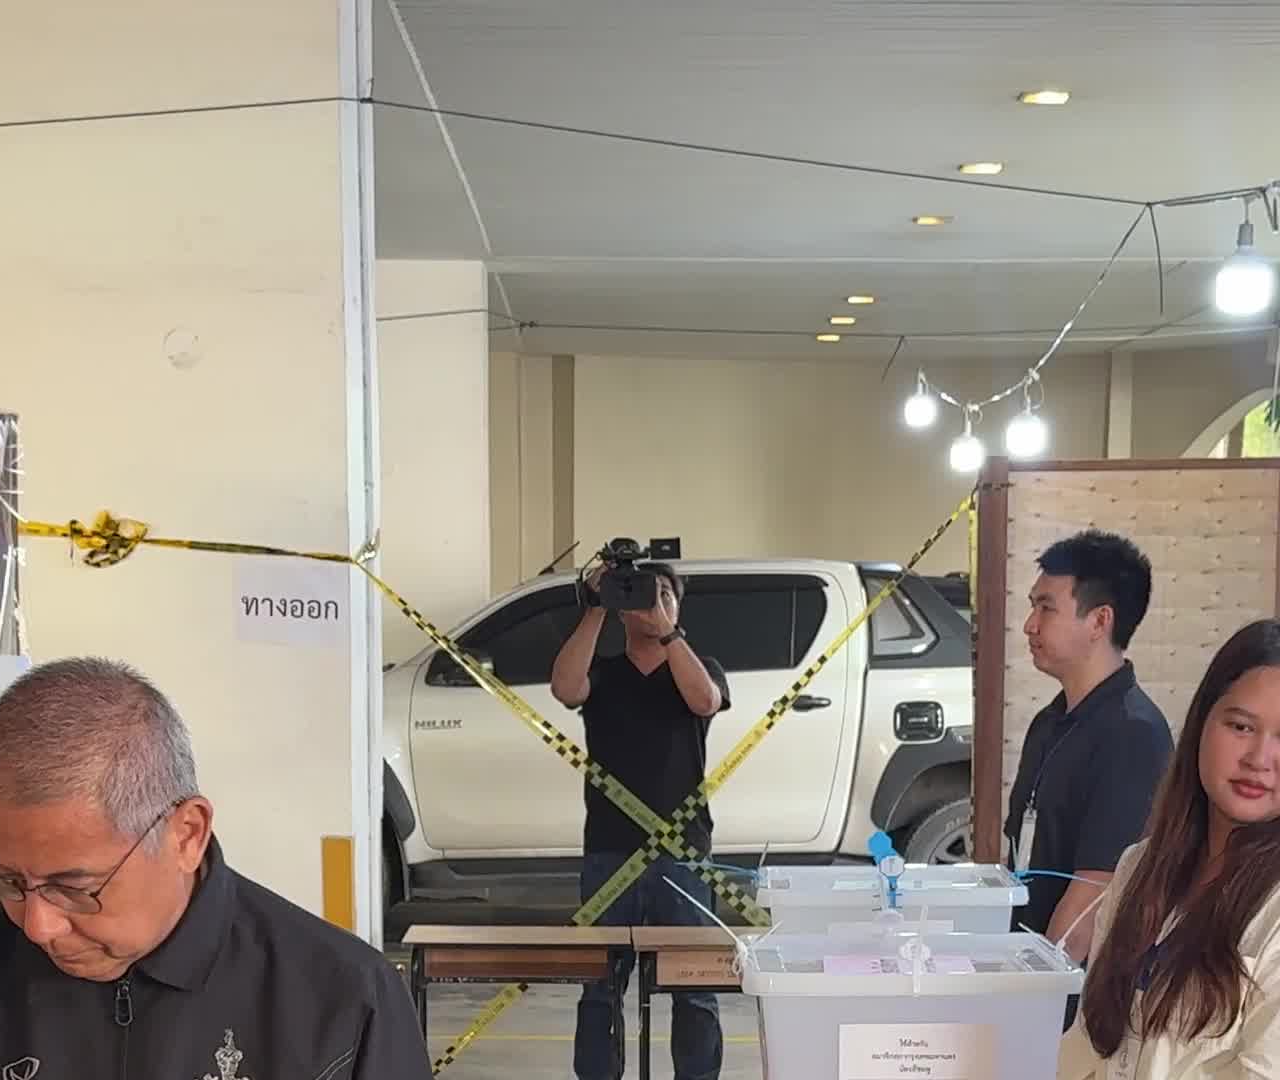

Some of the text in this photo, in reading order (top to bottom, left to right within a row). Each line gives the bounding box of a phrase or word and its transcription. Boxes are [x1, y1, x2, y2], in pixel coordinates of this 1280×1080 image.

[241, 596, 339, 620] ทางออก
[415, 719, 463, 729] HILUX
